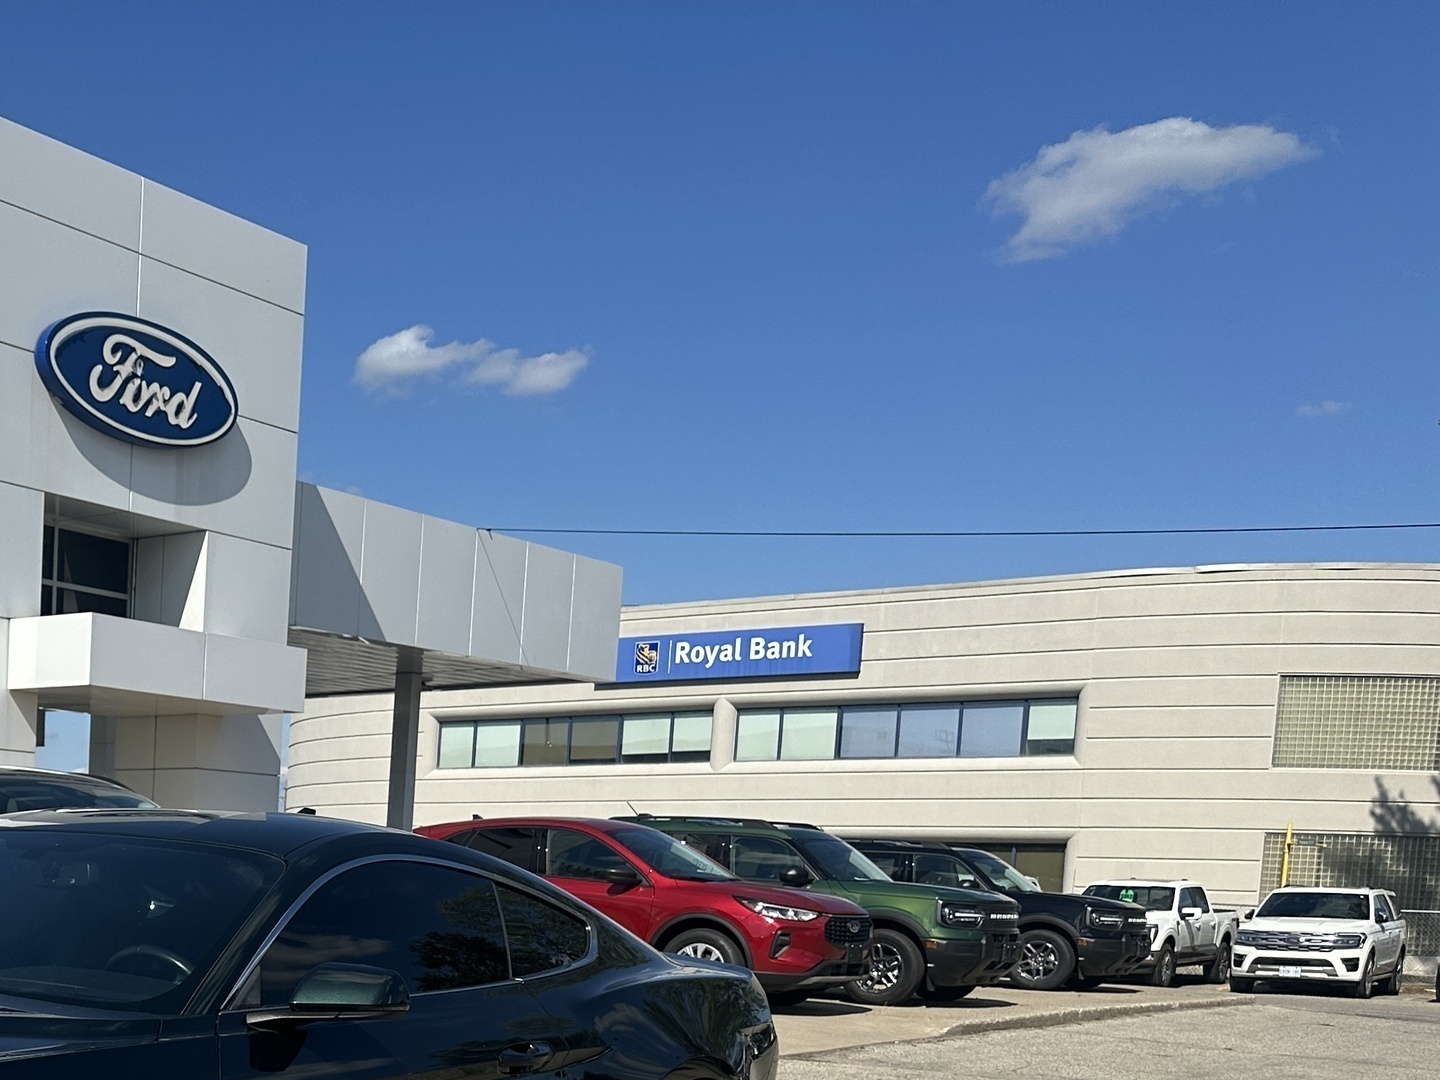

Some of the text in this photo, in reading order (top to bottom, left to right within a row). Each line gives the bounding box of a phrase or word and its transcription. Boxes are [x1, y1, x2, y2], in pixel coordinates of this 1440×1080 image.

[89, 333, 202, 430] Ford
[636, 664, 656, 673] RBC
[675, 633, 813, 669] Royal Bank
